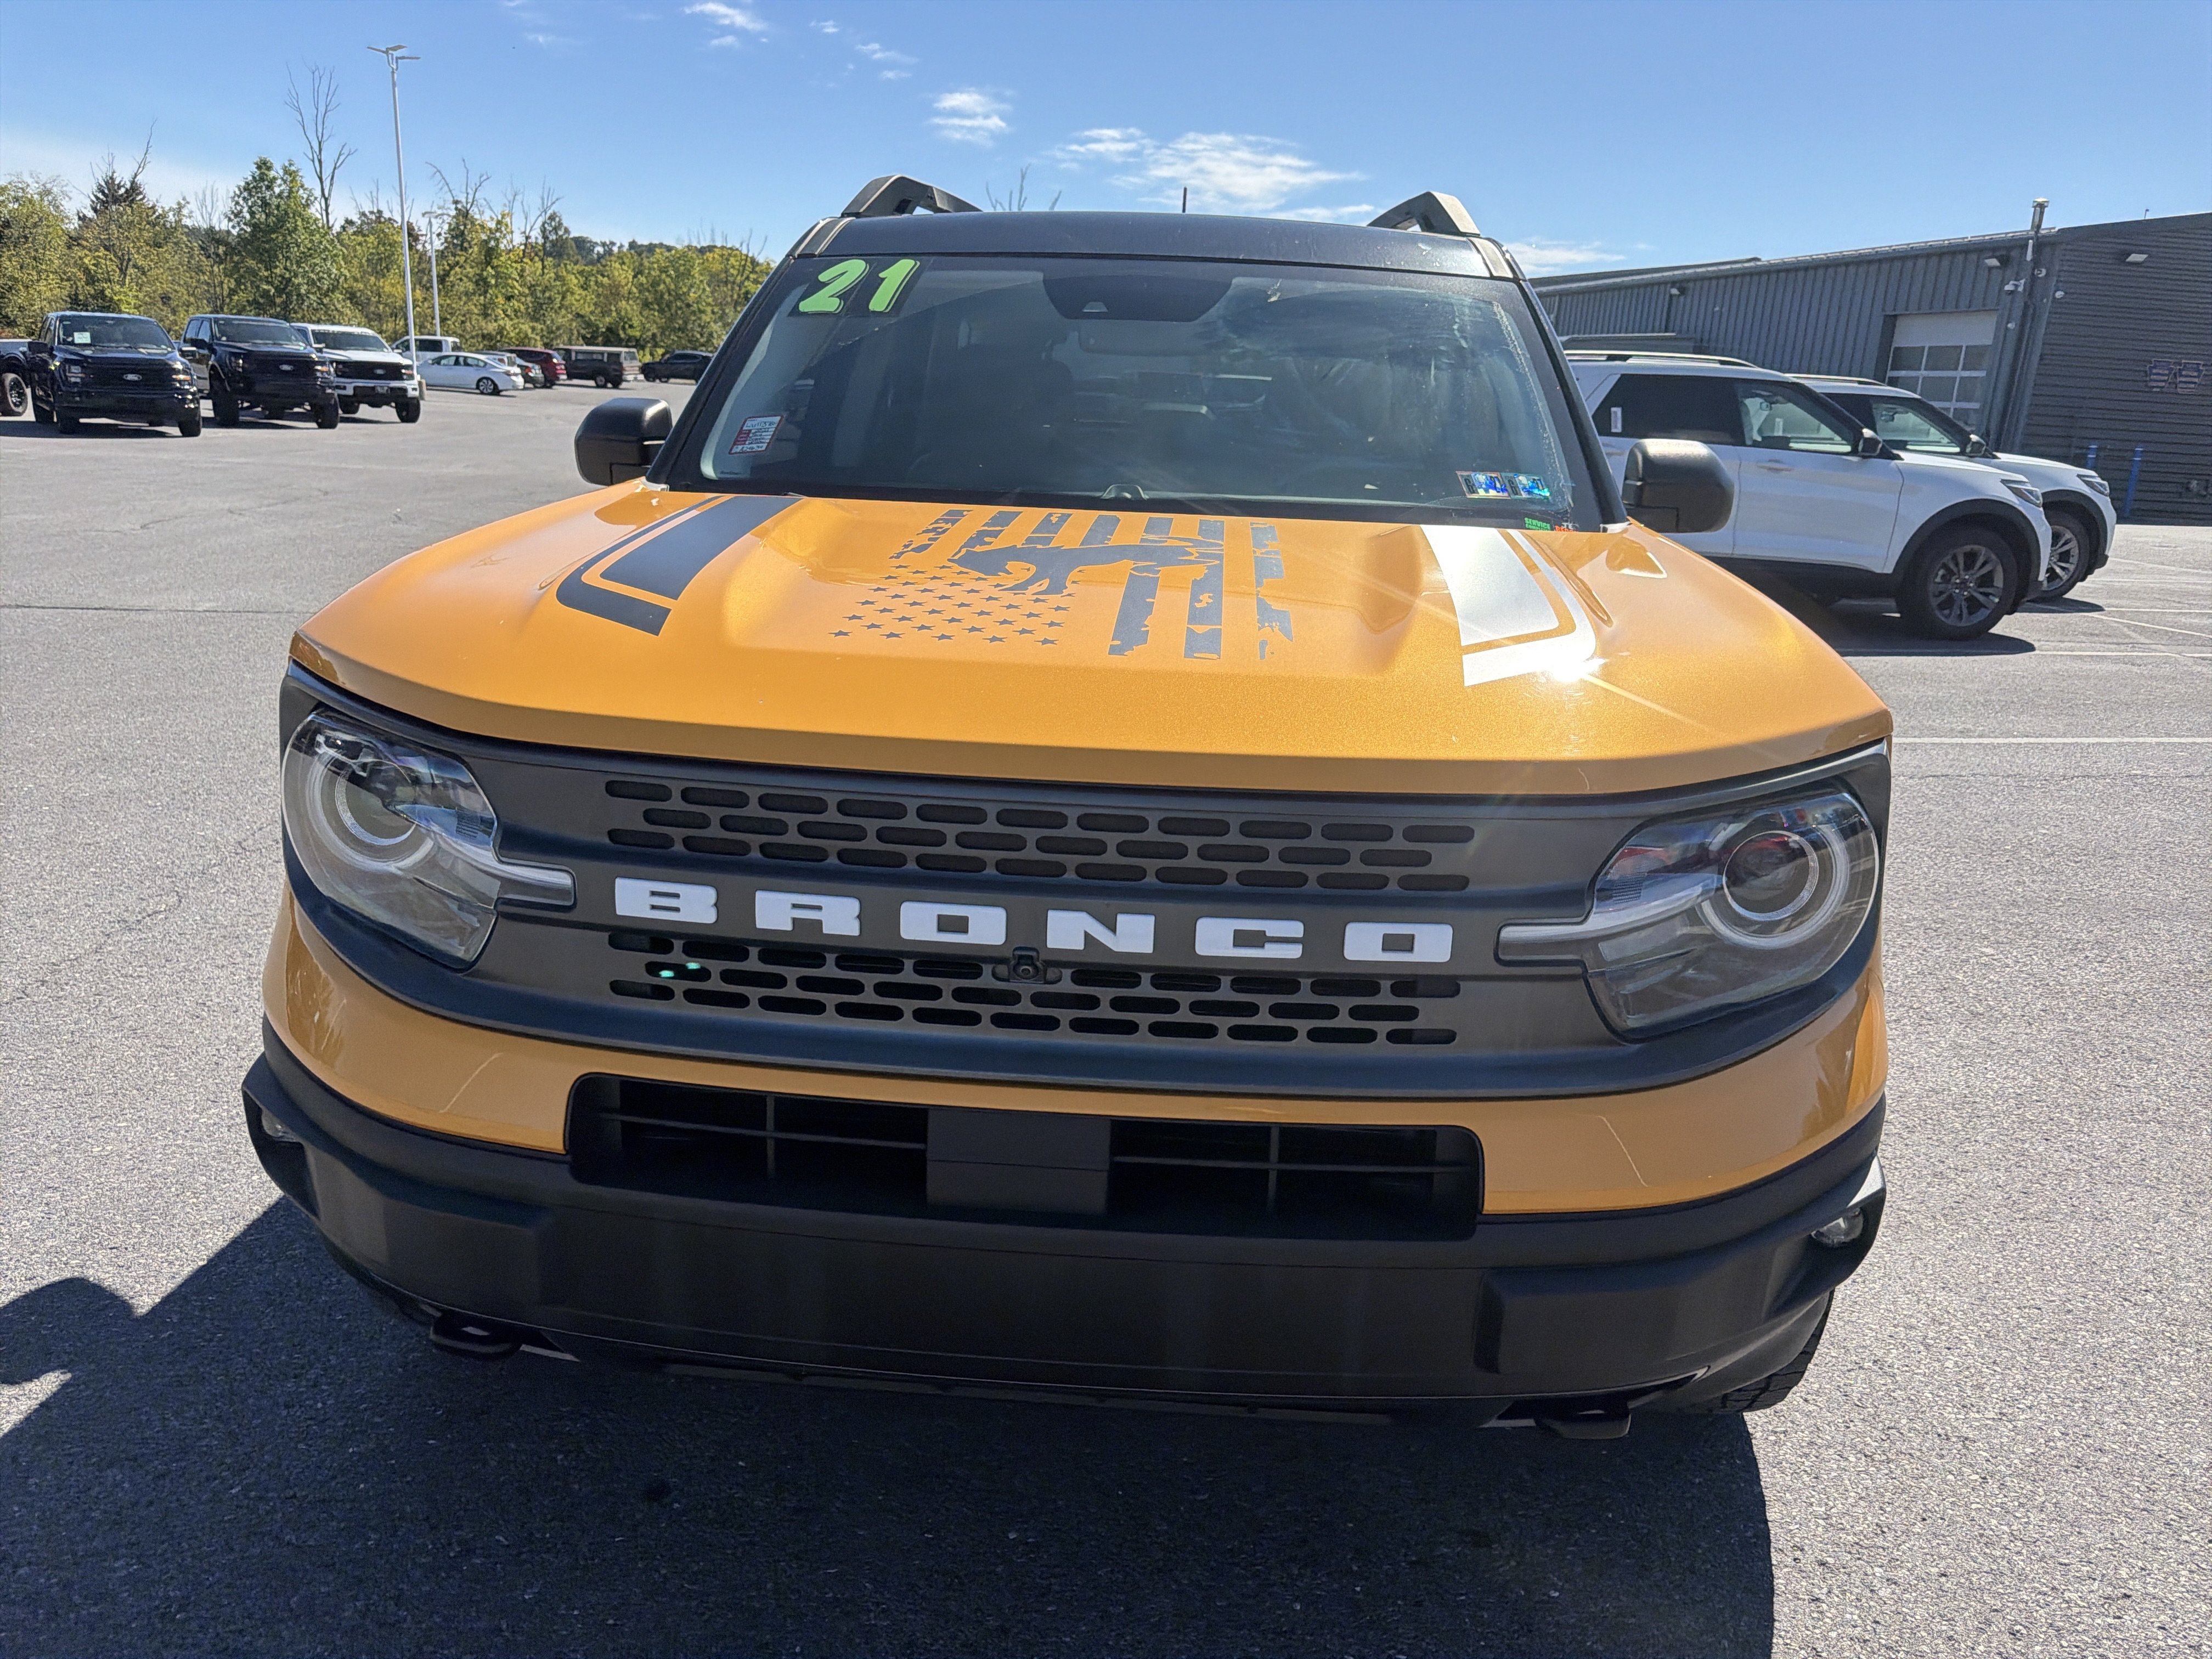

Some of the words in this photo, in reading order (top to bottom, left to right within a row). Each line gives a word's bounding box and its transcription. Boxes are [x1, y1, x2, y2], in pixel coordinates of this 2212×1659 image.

[799, 259, 920, 313] 21
[1524, 517, 1551, 530] SERVICE
[615, 877, 1454, 963] BRONCO
